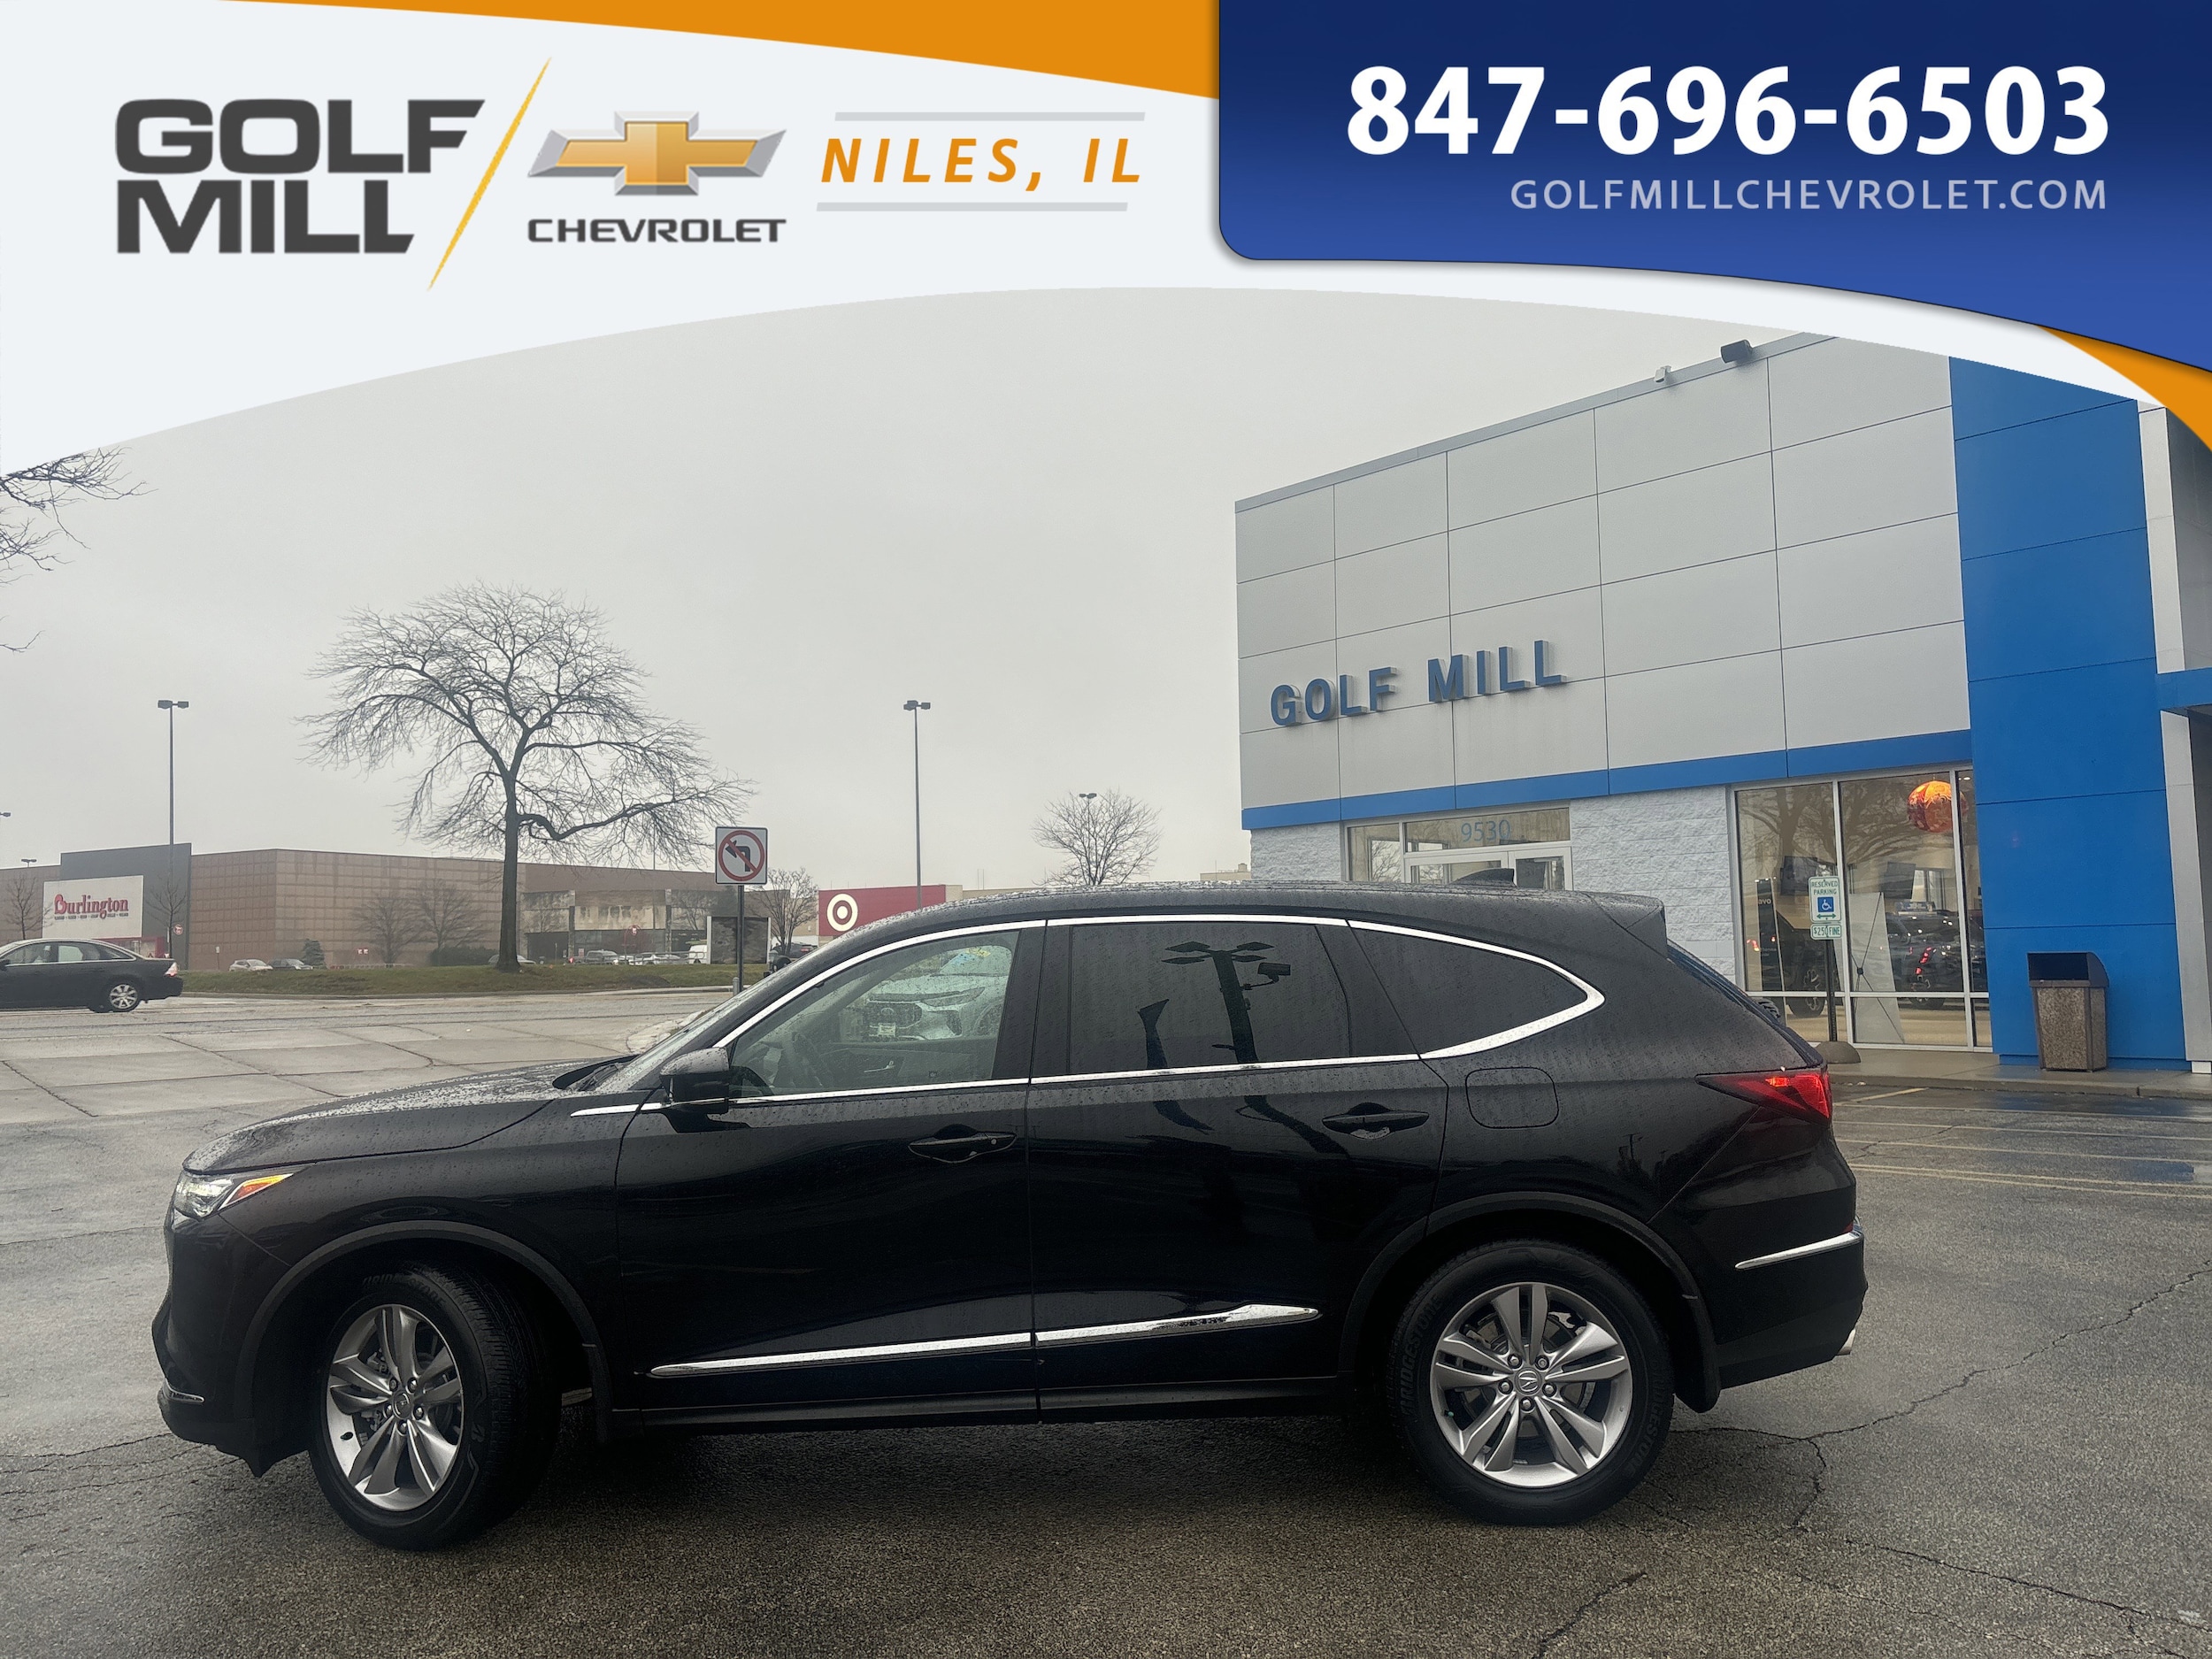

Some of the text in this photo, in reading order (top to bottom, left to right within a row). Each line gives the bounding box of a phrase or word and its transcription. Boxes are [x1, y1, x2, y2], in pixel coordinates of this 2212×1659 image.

[1271, 640, 1567, 726] GOLF MILL
[1461, 819, 1510, 842] 9530
[54, 894, 129, 919] Burlington
[1813, 926, 1840, 936] $250 FINE
